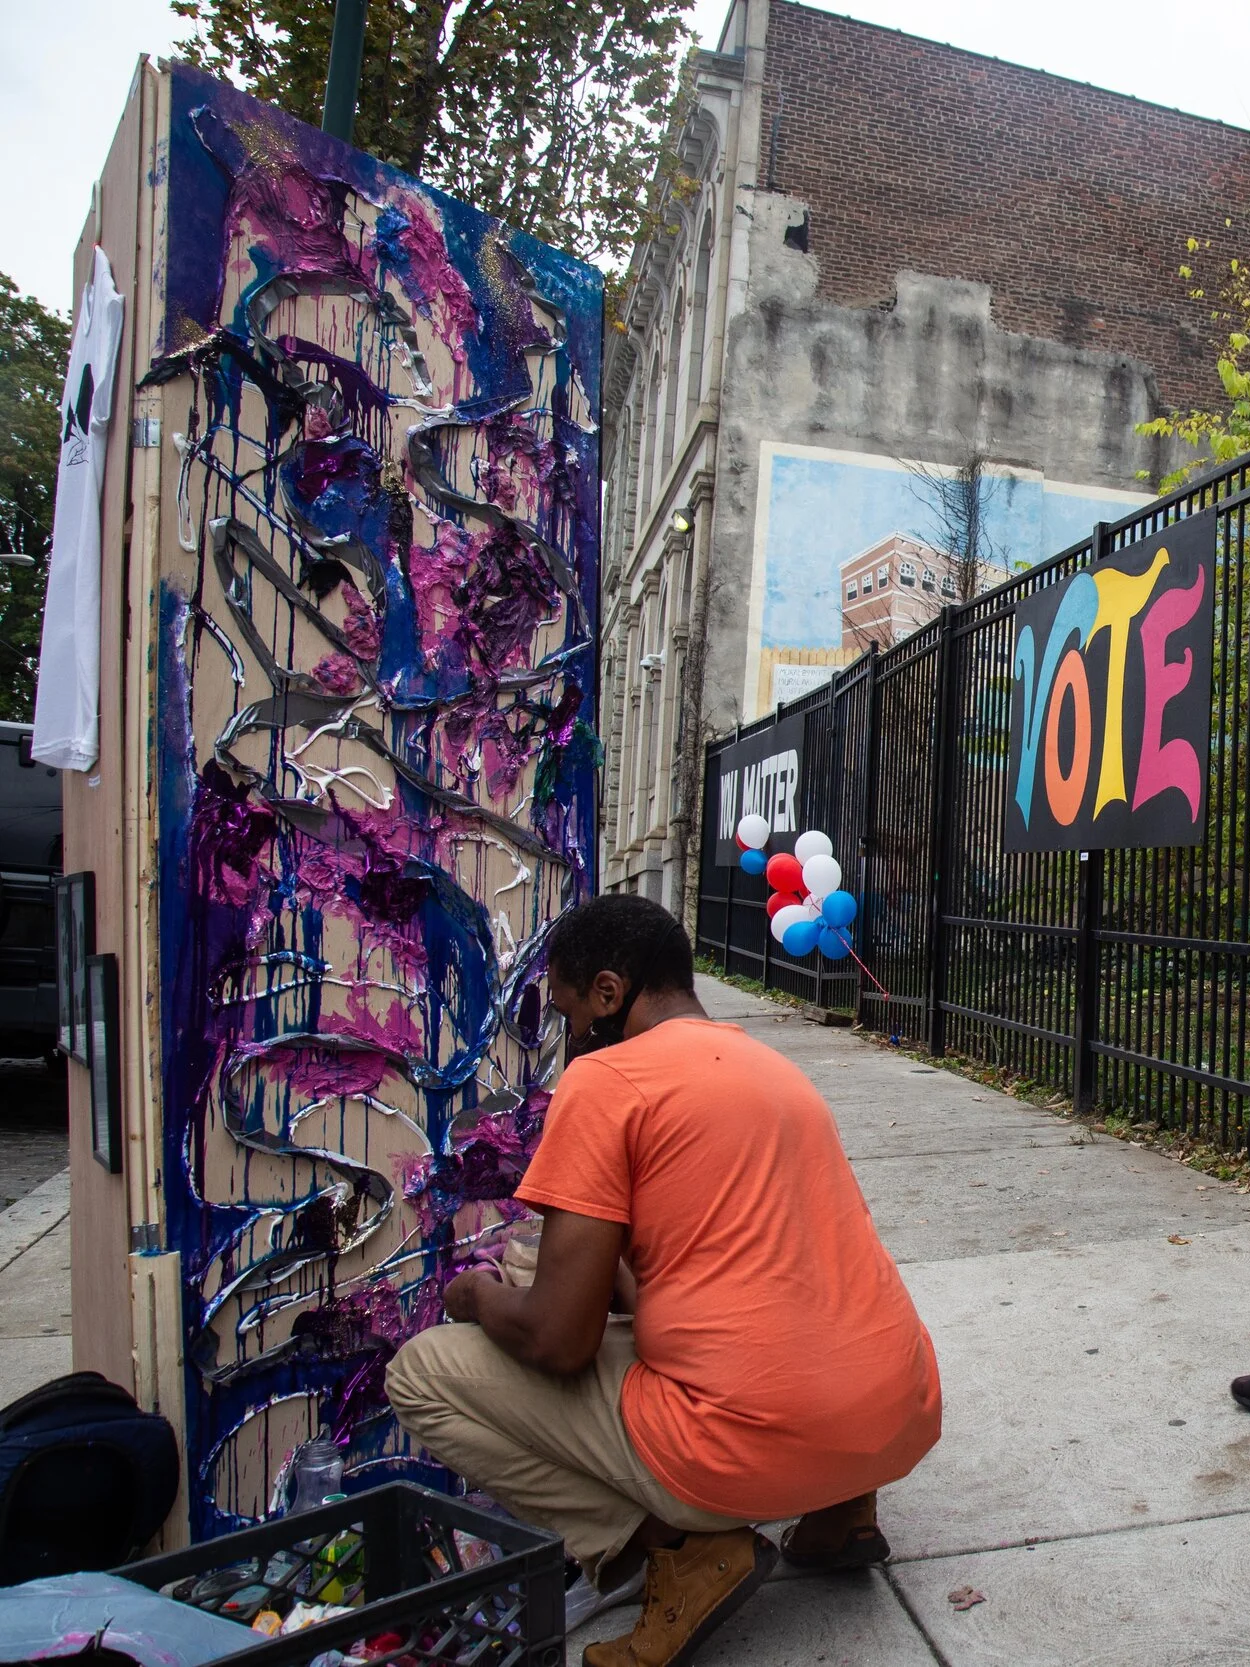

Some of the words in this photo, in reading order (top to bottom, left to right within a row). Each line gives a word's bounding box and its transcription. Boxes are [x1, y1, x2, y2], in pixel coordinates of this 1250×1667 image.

[1014, 547, 1205, 832] VOTE
[720, 769, 738, 840] YOU
[742, 749, 798, 833] MATTER
